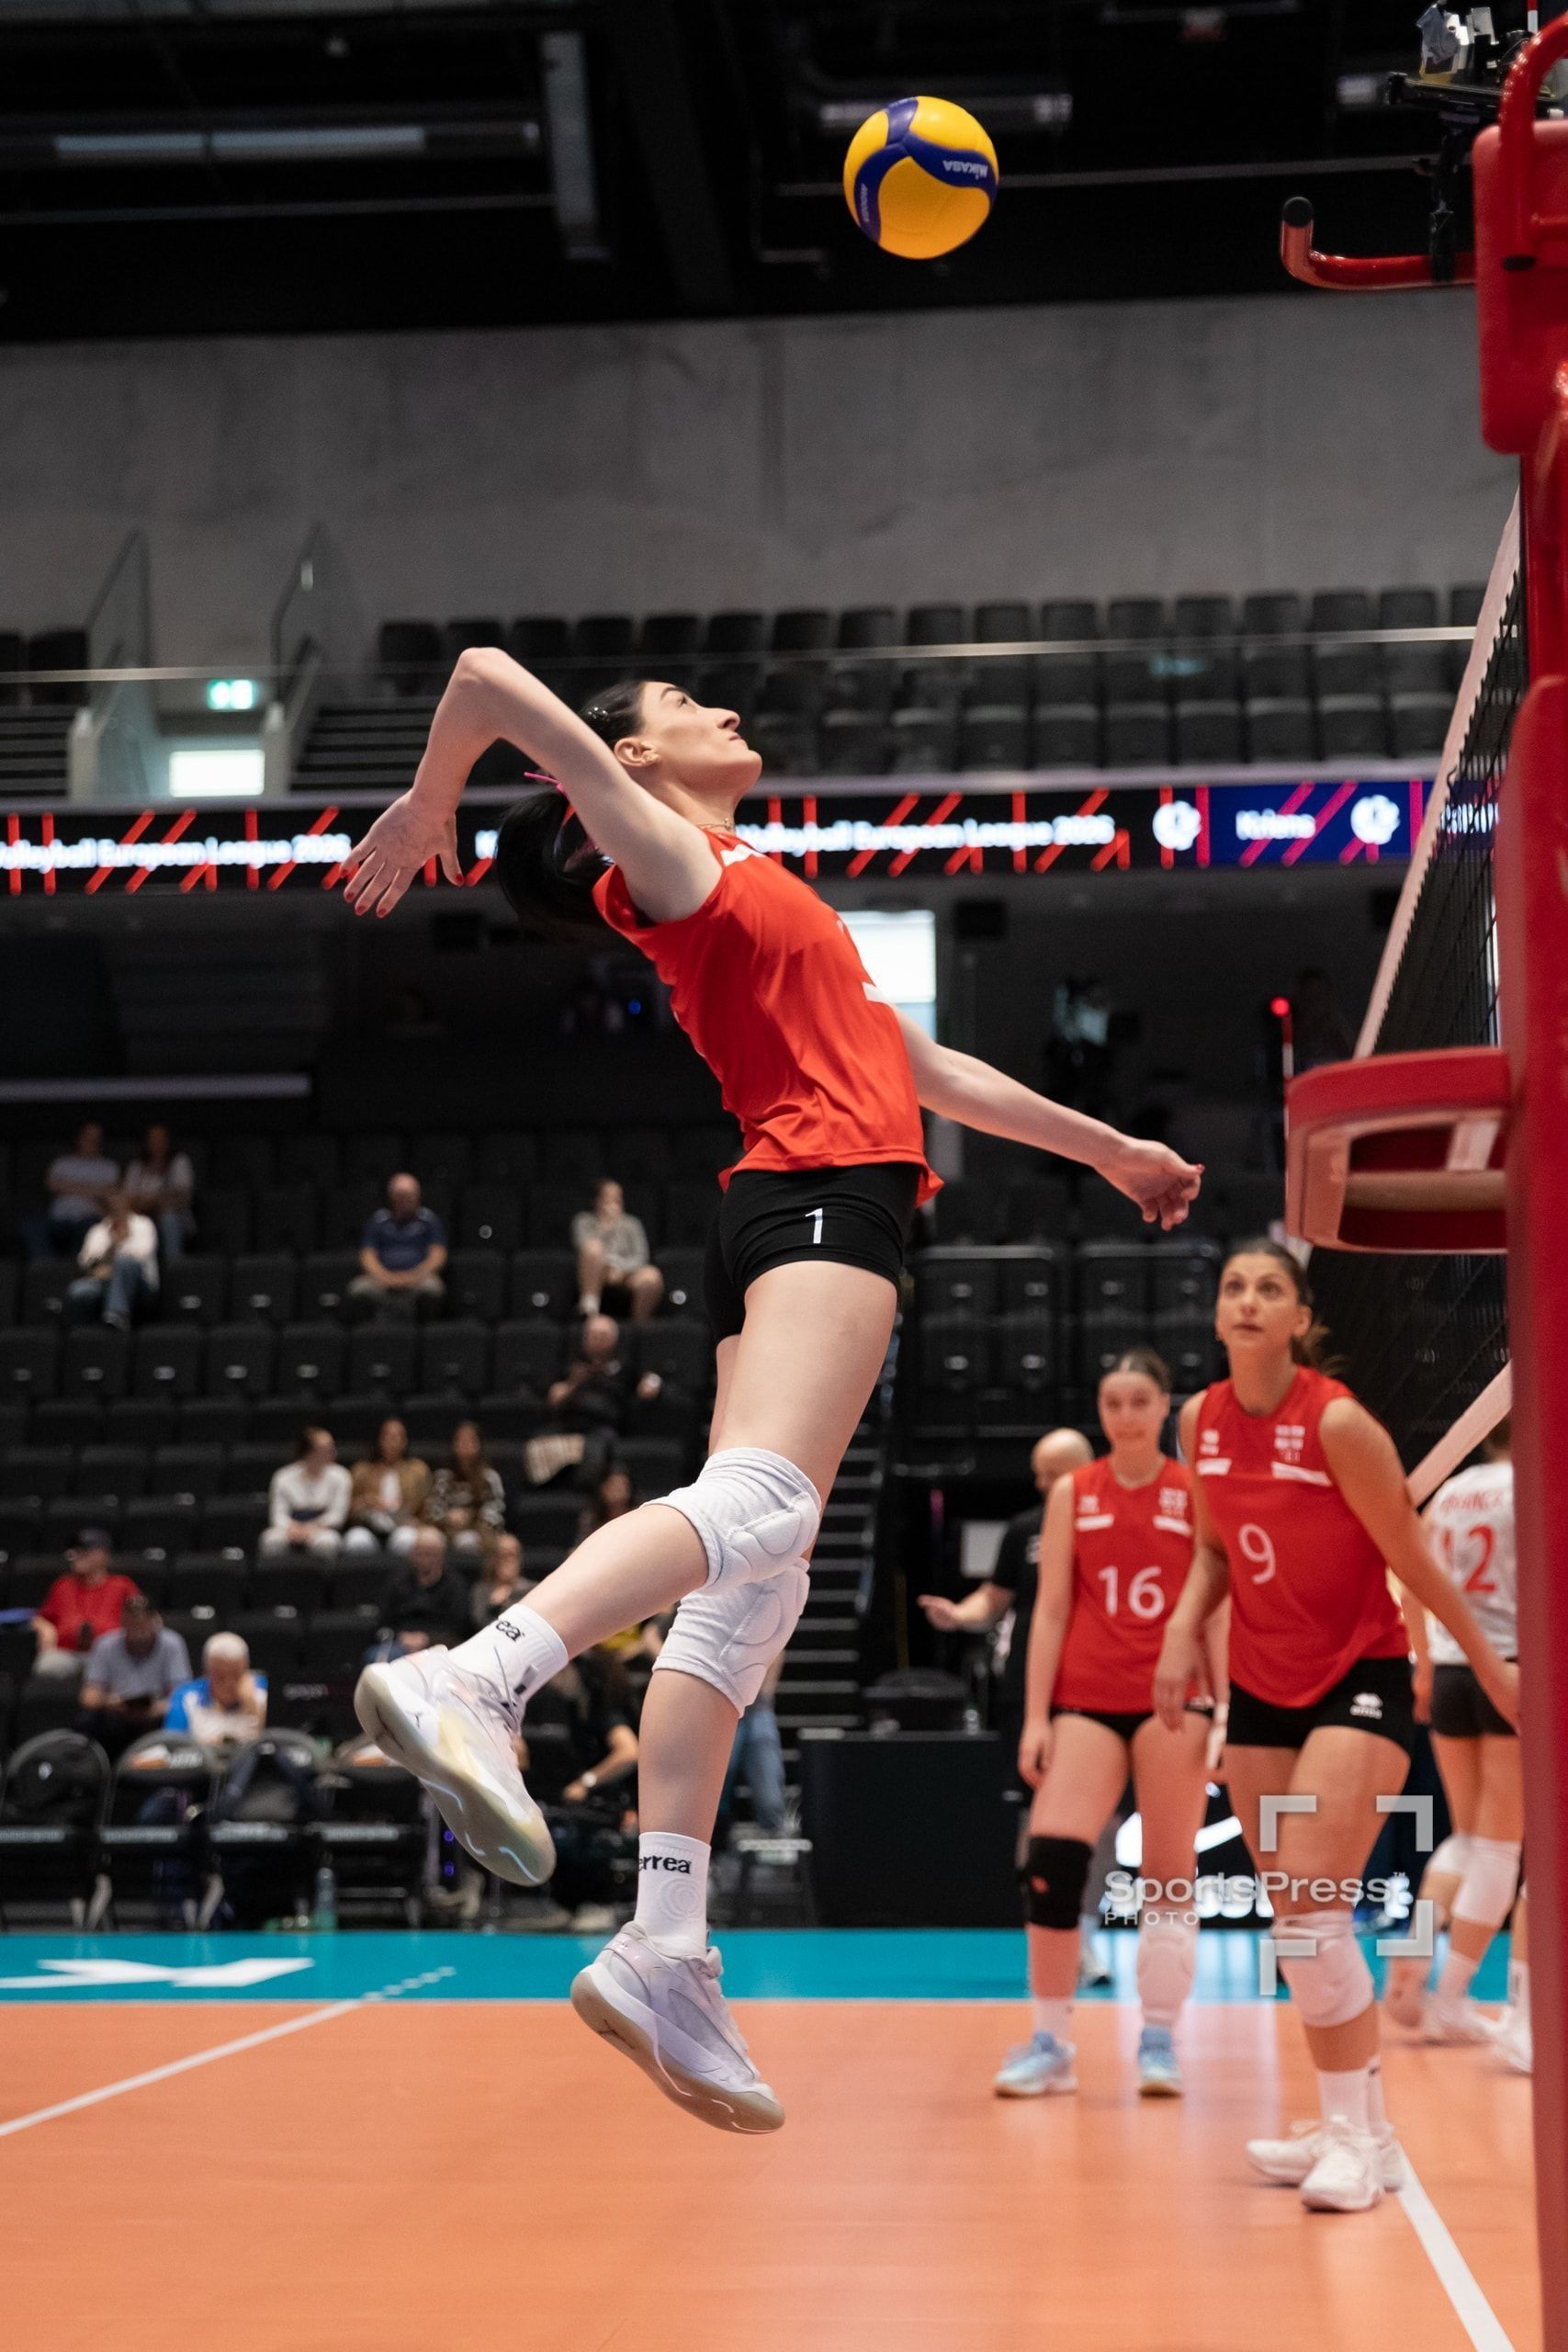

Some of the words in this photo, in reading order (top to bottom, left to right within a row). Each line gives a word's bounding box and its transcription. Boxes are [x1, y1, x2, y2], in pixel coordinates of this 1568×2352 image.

[805, 1207, 824, 1244] 1
[1239, 1523, 1276, 1585] 9
[1098, 1566, 1166, 1620] 16
